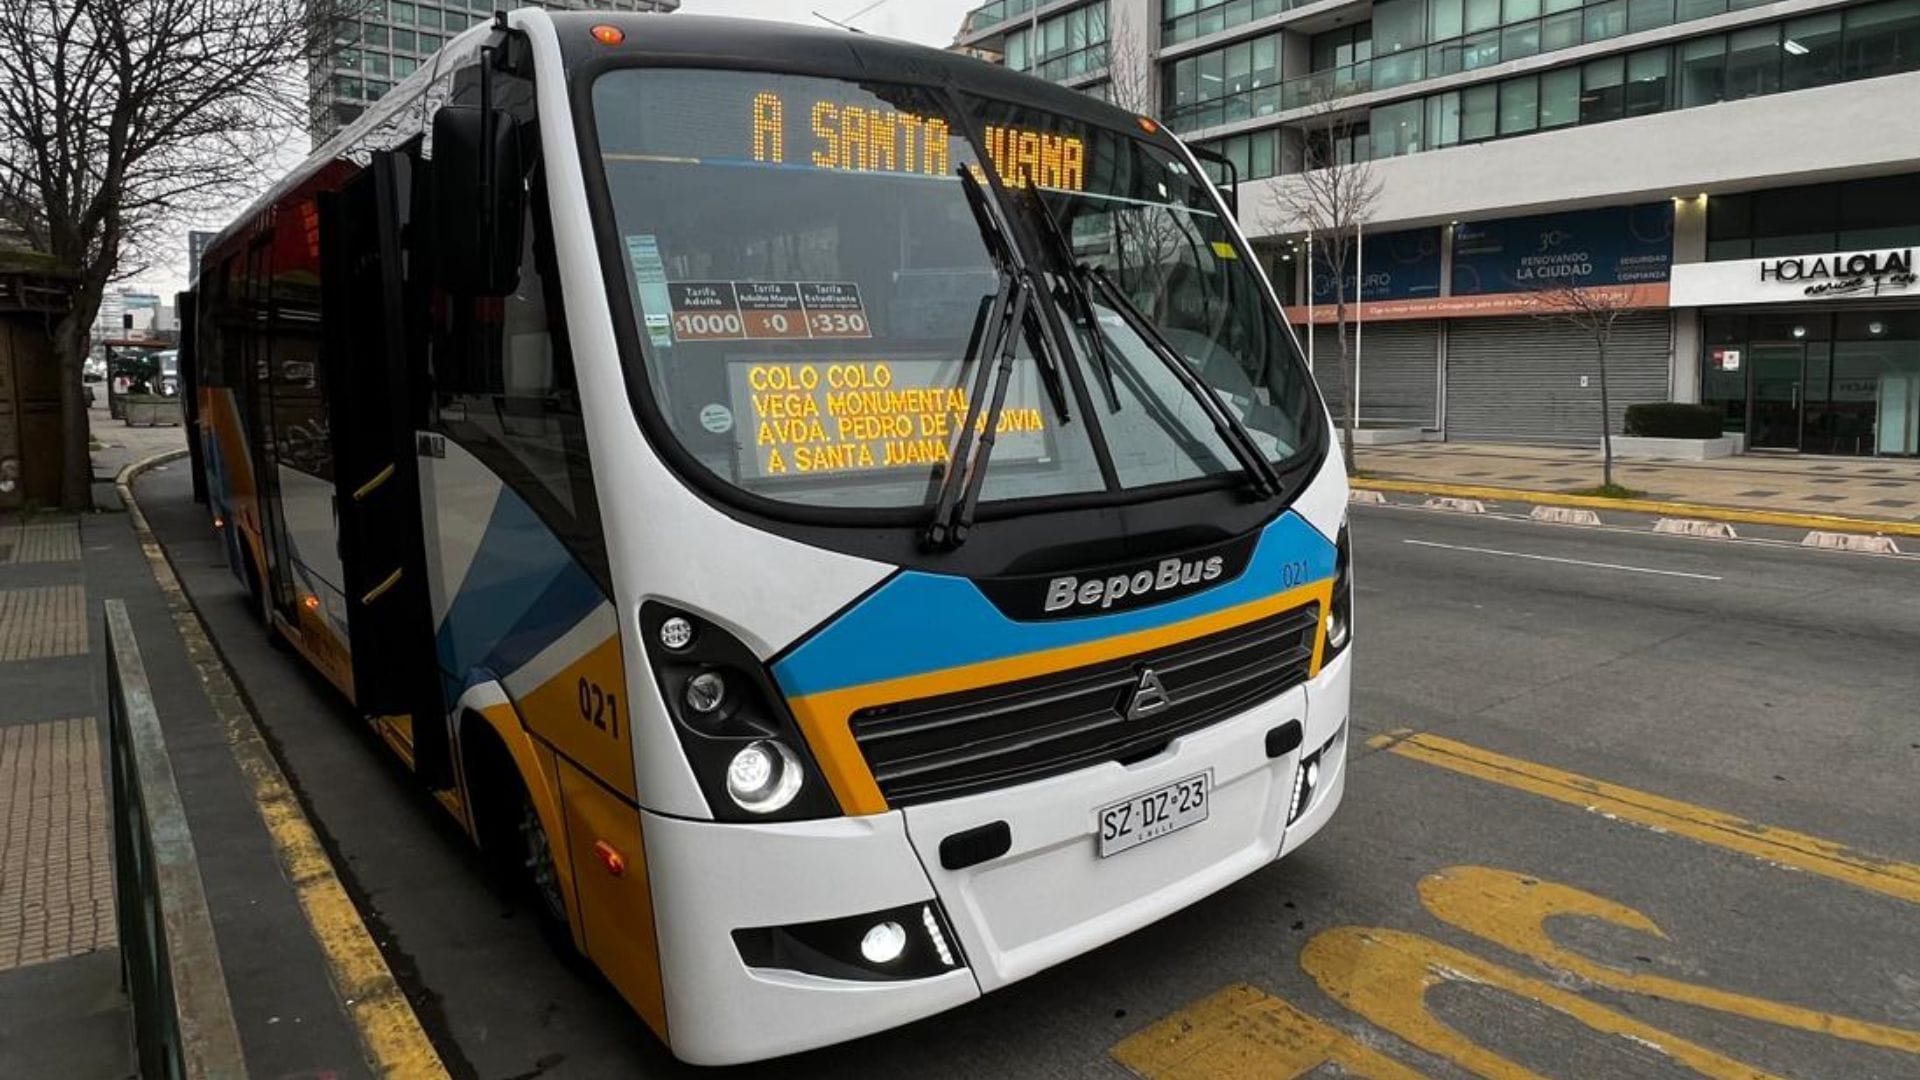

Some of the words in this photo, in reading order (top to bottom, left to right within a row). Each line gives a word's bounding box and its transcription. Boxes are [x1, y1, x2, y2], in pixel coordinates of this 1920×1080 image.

[754, 93, 783, 164] A
[812, 101, 948, 176] SANTA
[1516, 268, 1534, 280] LA
[1536, 263, 1593, 278] CIUDAD
[1520, 252, 1589, 267] RENOVANDO
[1761, 258, 1830, 281] HOLA
[1834, 249, 1912, 278] LOLA!
[684, 297, 722, 306] Adulto
[685, 287, 717, 296] Tarifa
[753, 284, 782, 294] Tarifa
[815, 285, 842, 294] Tarifa
[749, 365, 817, 392] COLO
[826, 364, 890, 389] COLO
[752, 394, 818, 419] VEGA
[826, 387, 969, 417] MONUMENTAL
[757, 420, 831, 446] AVDA.
[839, 416, 913, 441] PEDRO
[921, 412, 949, 437] DE
[954, 408, 1044, 433] VADIVIA
[768, 448, 787, 473] A
[795, 443, 874, 472] SANTA
[883, 439, 951, 465] JUANA
[1045, 556, 1224, 611] BepoBus
[1282, 560, 1308, 588] 021
[578, 675, 619, 740] 021
